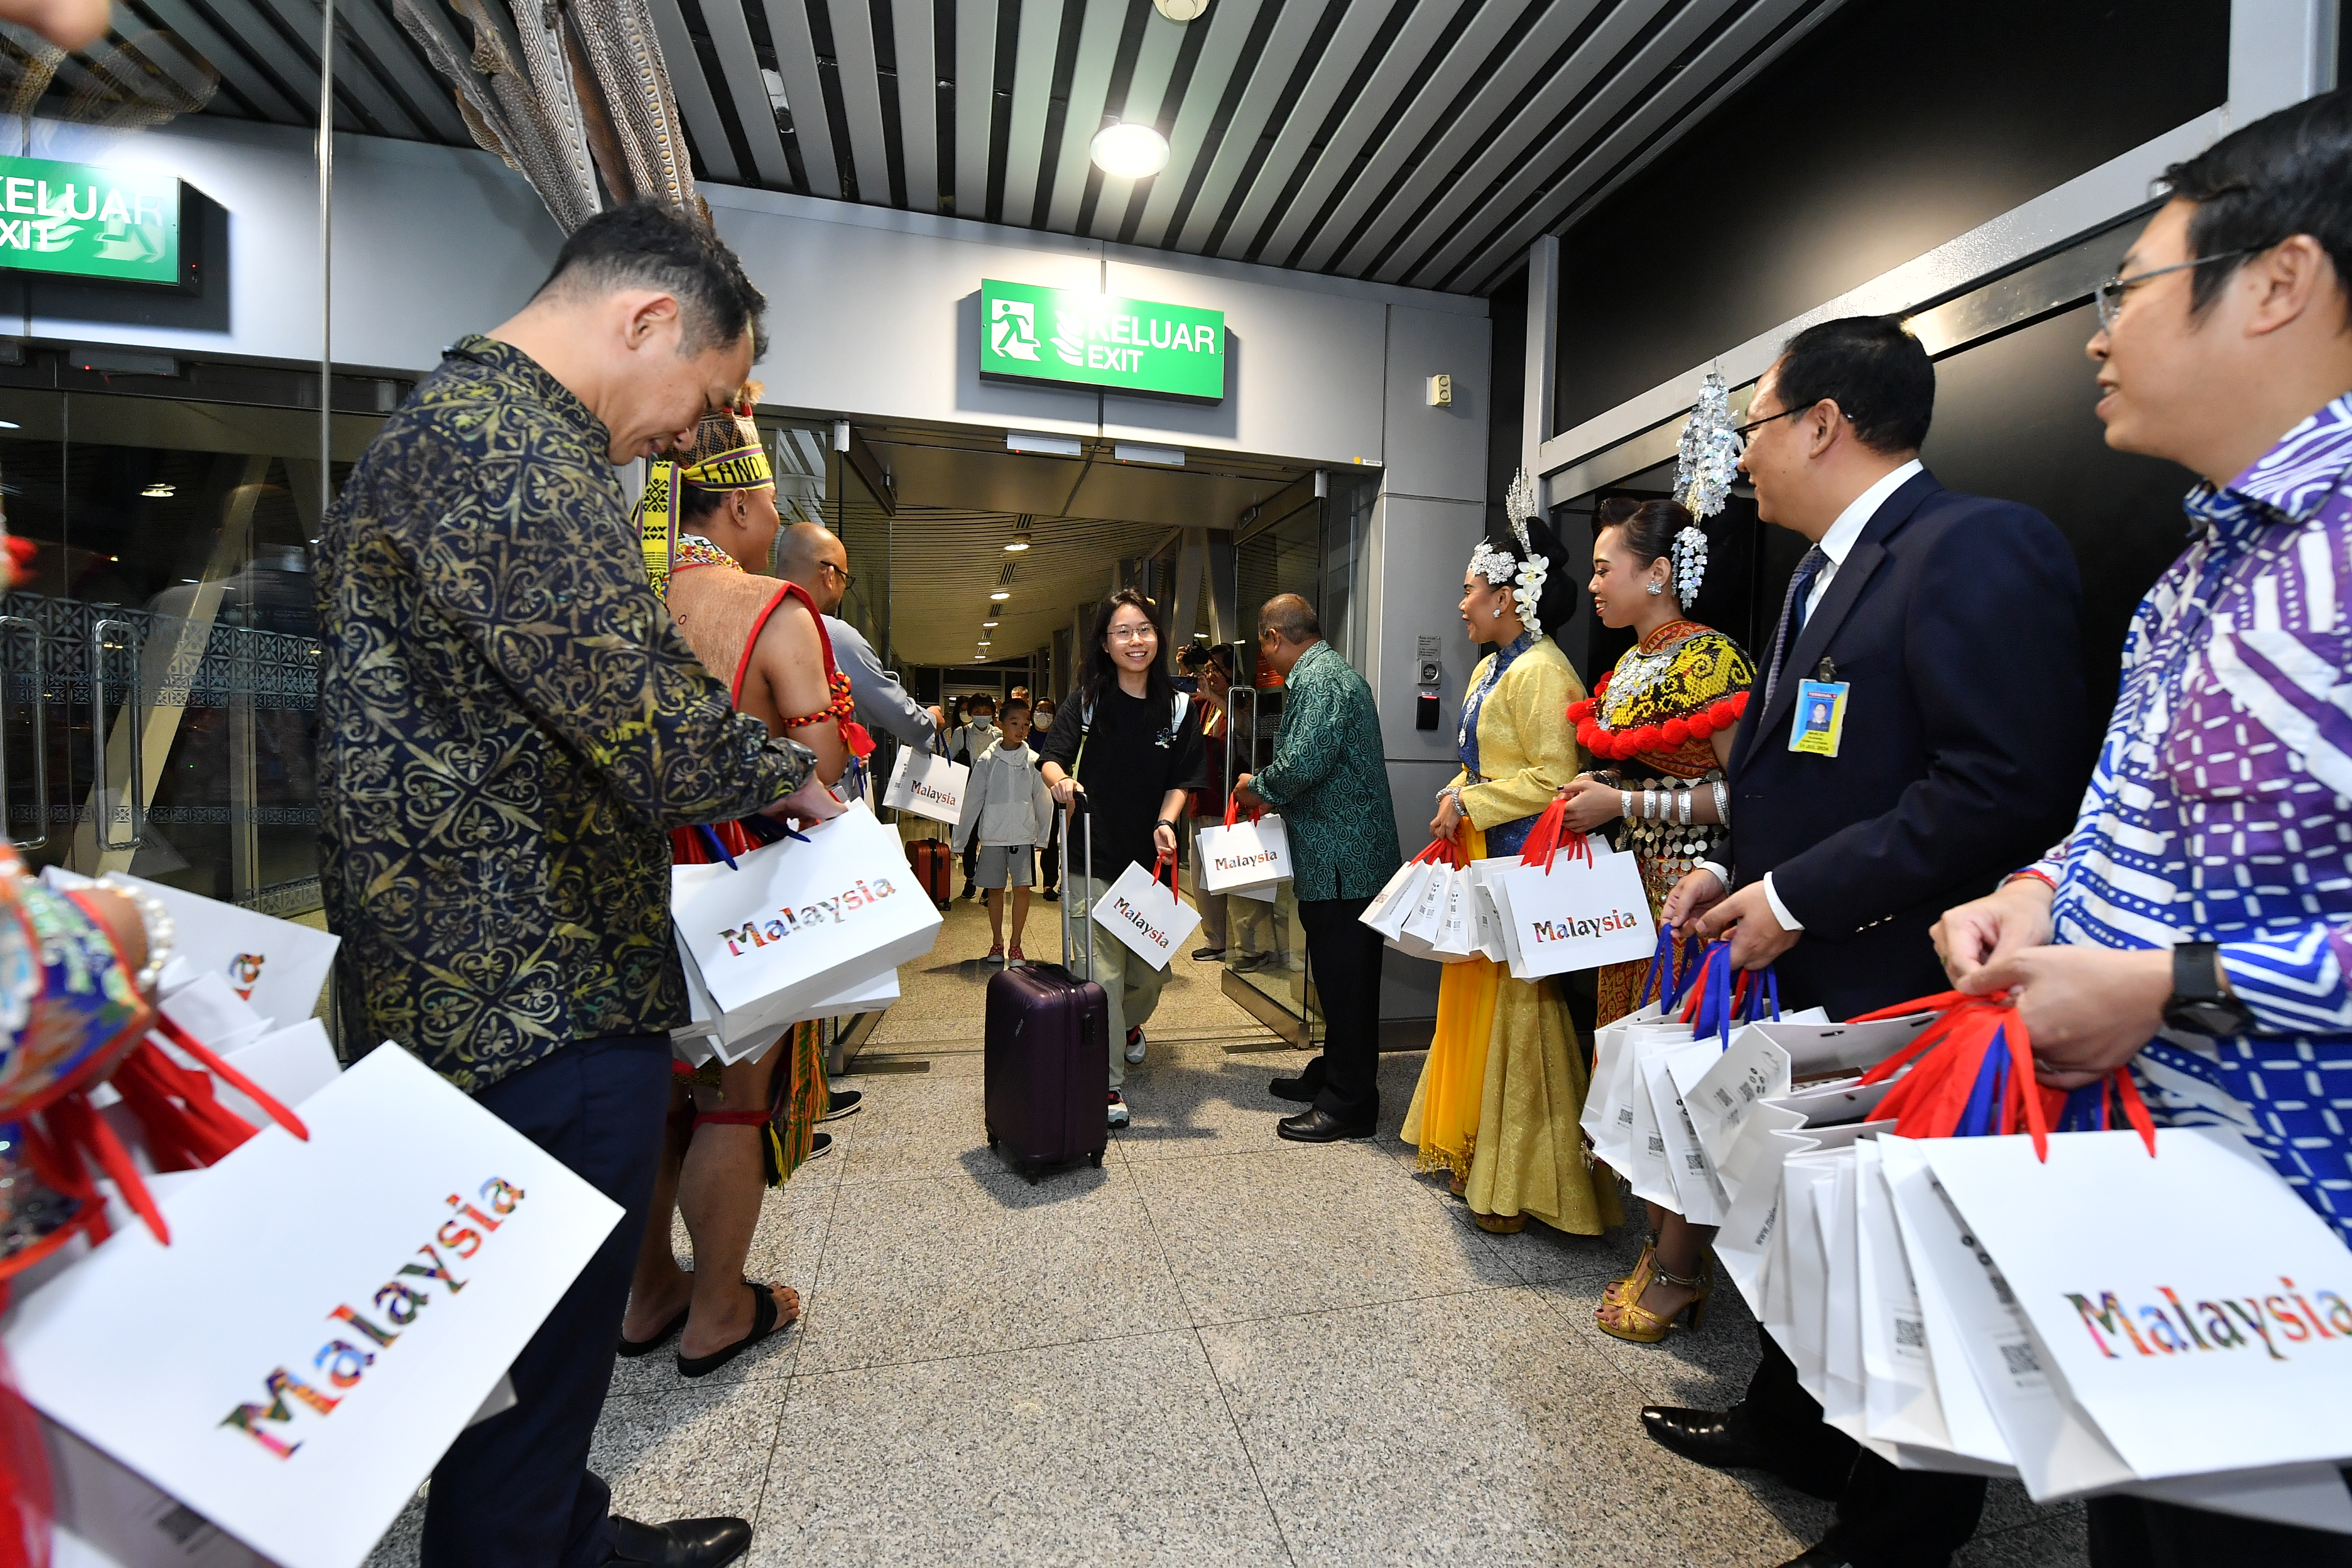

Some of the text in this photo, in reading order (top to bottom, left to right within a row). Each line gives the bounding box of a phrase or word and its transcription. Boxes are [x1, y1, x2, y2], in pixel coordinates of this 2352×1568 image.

[0, 175, 163, 226] ELUAR
[0, 219, 56, 251] XIT
[1088, 313, 1215, 354] KELUAR
[1088, 344, 1144, 373] EXIT
[911, 779, 956, 805] Malaysia
[1215, 849, 1278, 871] Malaysia
[718, 878, 896, 956] Malaysia
[1112, 896, 1170, 949] Malaysia
[1532, 909, 1637, 943] Malaysia
[215, 1174, 527, 1460] Malaysia
[2063, 1276, 2352, 1361] Malaysia
